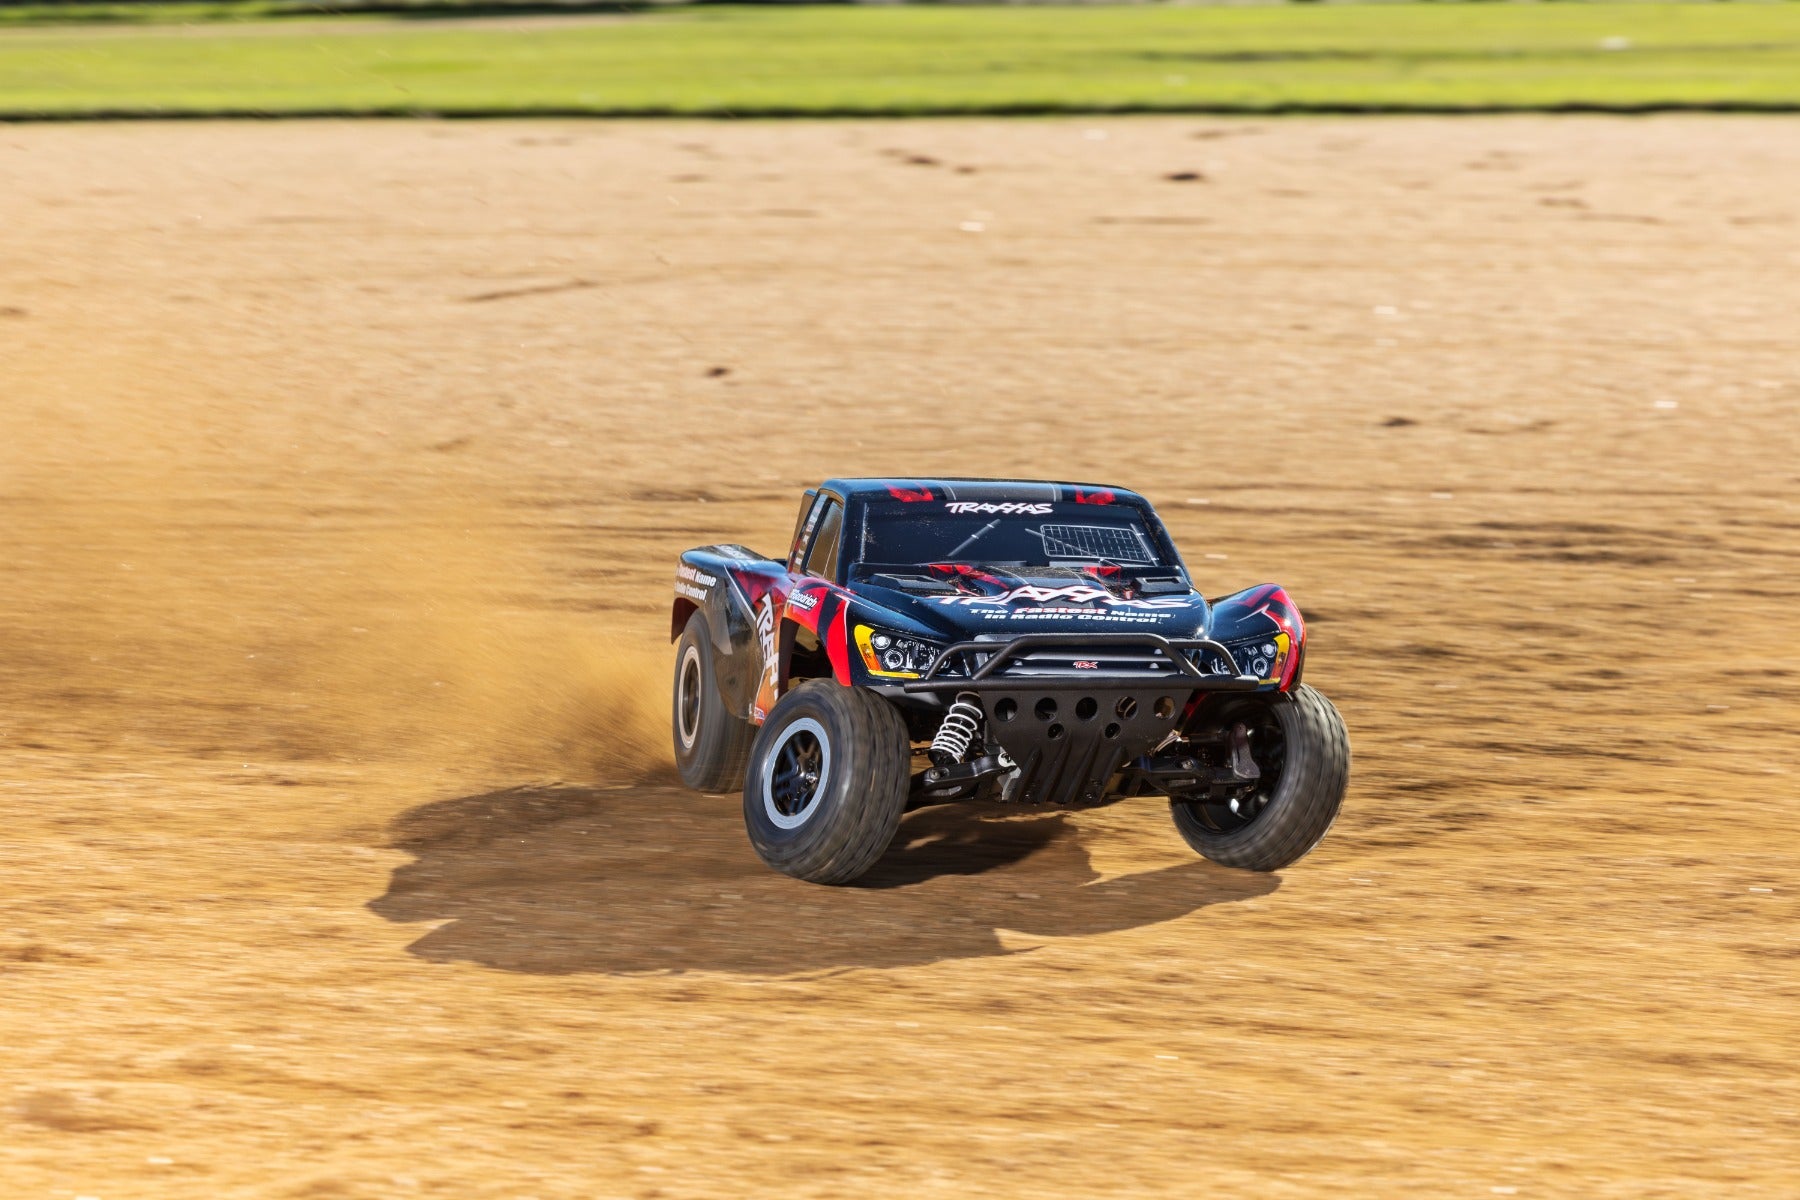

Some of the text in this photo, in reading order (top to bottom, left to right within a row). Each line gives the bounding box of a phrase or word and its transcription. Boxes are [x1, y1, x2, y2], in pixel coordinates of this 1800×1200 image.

[945, 502, 1054, 515] TRAXXAS
[695, 571, 717, 588] Name
[927, 584, 1194, 609] TRAXXAS
[1013, 607, 1108, 615] Fastest
[1111, 610, 1172, 618] Name
[1077, 614, 1157, 623] Control
